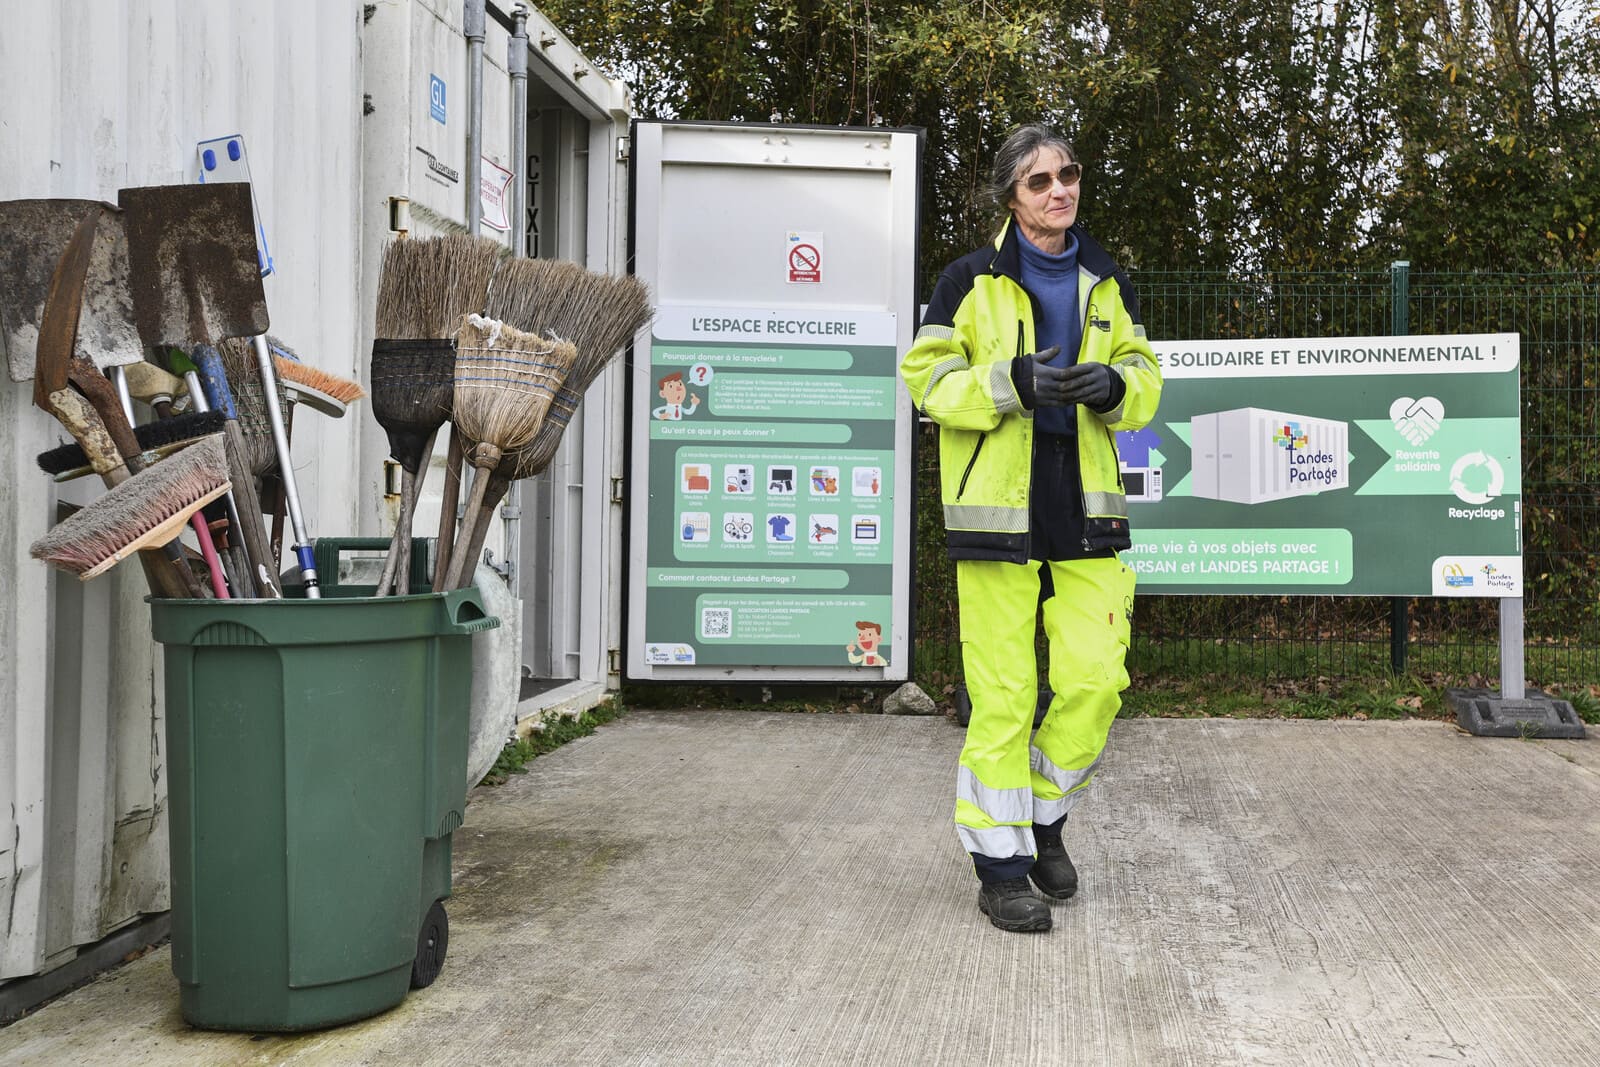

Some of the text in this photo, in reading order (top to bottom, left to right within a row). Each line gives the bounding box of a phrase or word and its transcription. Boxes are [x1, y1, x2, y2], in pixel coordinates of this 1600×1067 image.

[431, 79, 445, 110] GL
[692, 318, 857, 335] L'ESPACE RECYCLERIE
[663, 353, 696, 363] Pourquoi
[697, 353, 724, 361] donner
[726, 353, 732, 361] à
[733, 353, 740, 361] la
[742, 354, 777, 364] recyclerie
[1169, 351, 1265, 367] SOLIDAIRE
[1271, 350, 1290, 365] ET
[1298, 346, 1485, 365] ENVIRONNEMENTAL
[1492, 346, 1497, 360] !
[696, 367, 707, 381] ?
[661, 427, 686, 435] Qu'est
[698, 428, 712, 437] que
[713, 427, 721, 437] je
[722, 428, 741, 437] peux
[743, 428, 769, 436] donner
[1290, 449, 1333, 464] Landes
[1395, 450, 1440, 461] Revente
[1395, 461, 1441, 473] solidaire
[1290, 466, 1337, 484] Partage
[1448, 507, 1505, 520] Recyclage
[1162, 541, 1184, 554] vie
[1189, 540, 1198, 554] à
[1202, 543, 1227, 554] vos
[1231, 541, 1277, 557] objets
[1281, 543, 1317, 554] avec
[1181, 561, 1196, 573] et
[1200, 561, 1258, 574] LANDES
[1263, 560, 1329, 573] PARTAGE
[658, 574, 694, 582] Comment
[696, 574, 731, 583] contacter
[732, 574, 759, 583] Landes
[761, 575, 790, 584] Partage
